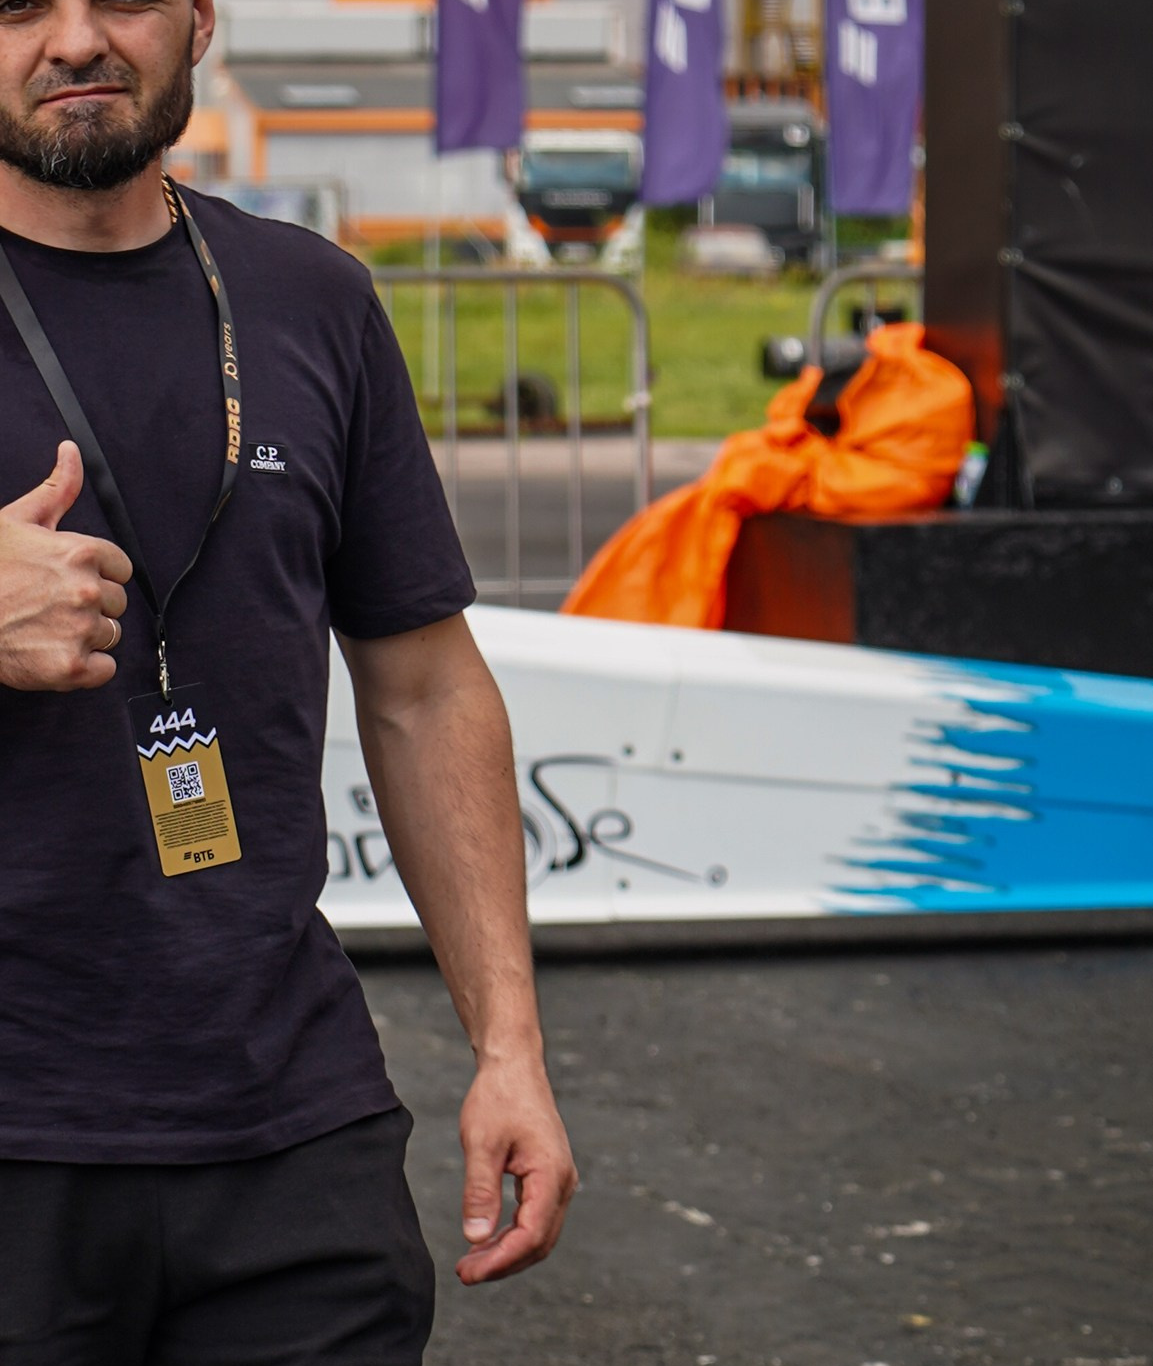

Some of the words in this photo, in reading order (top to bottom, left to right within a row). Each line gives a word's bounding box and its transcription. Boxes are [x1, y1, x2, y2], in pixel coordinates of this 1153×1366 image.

[223, 322, 237, 361] years
[226, 397, 241, 465] RDRC
[250, 459, 286, 471] COMPANY
[150, 708, 196, 735] 444
[193, 849, 216, 864] ВТБ
